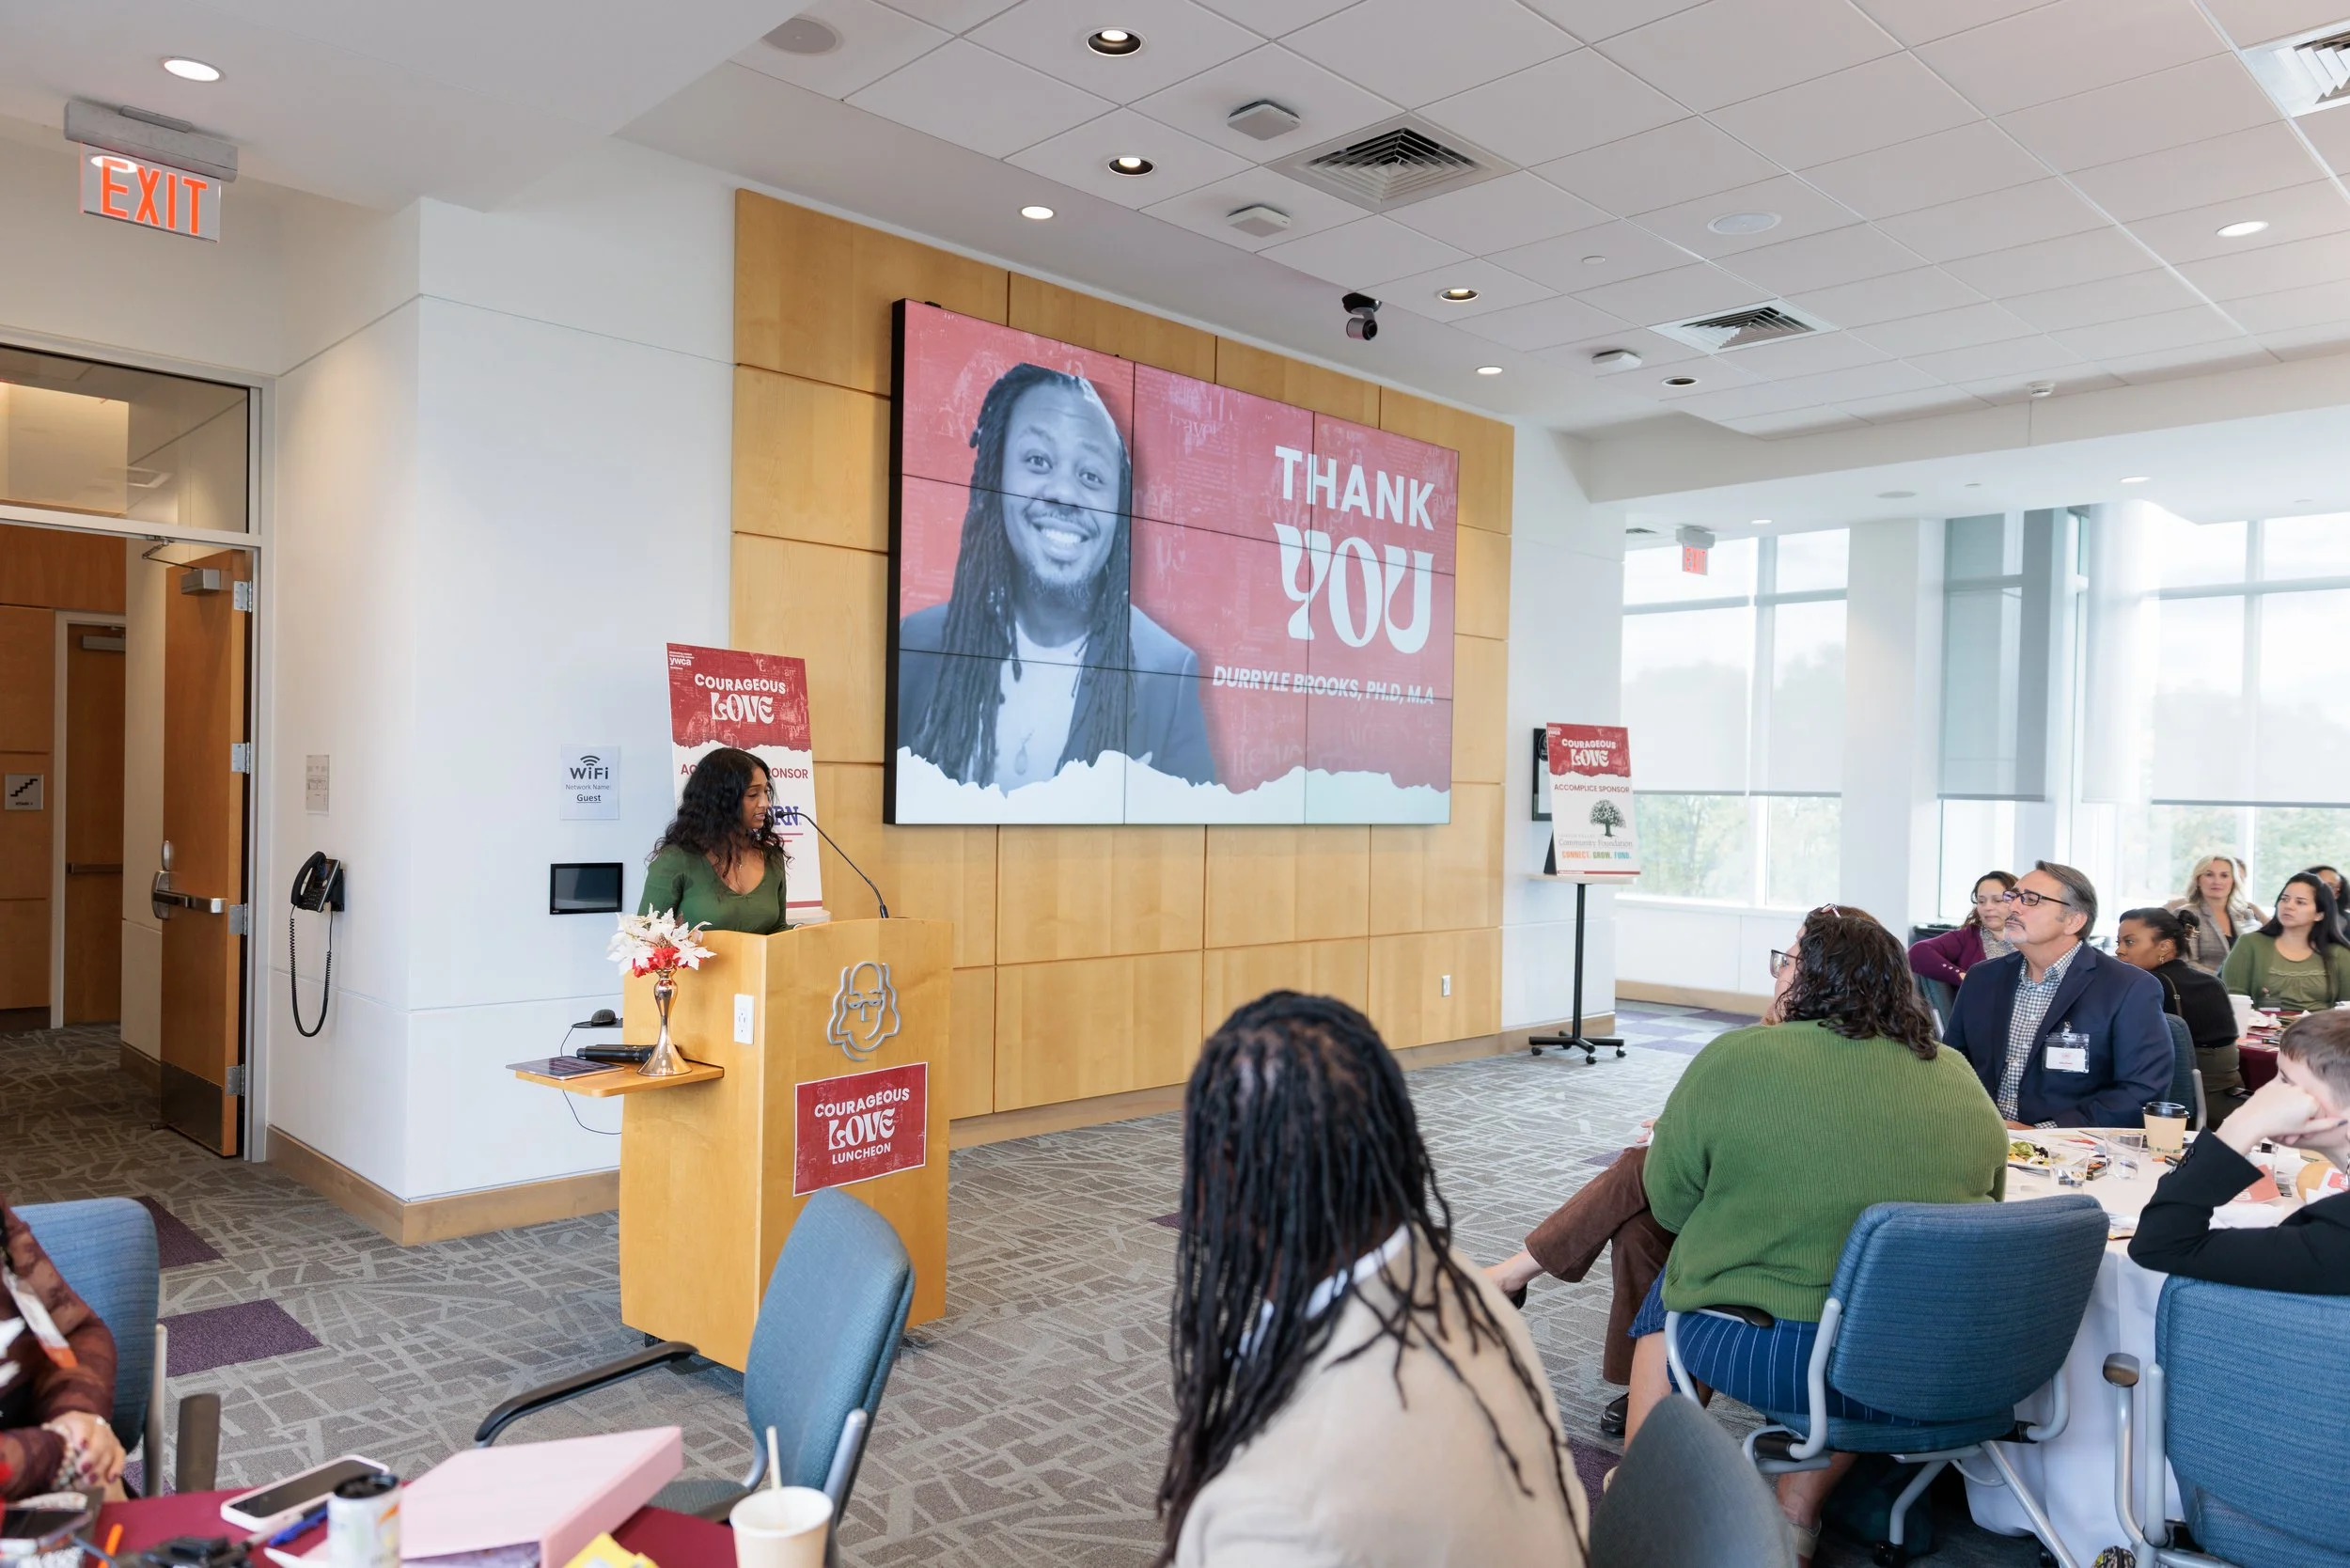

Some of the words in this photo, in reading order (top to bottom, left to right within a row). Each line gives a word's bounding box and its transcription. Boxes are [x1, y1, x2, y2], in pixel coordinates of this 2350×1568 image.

[101, 155, 208, 235] EXIT
[1275, 445, 1435, 531] THANK
[1685, 546, 1707, 573] EXIT
[1273, 522, 1434, 654] YOU
[669, 657, 692, 666] ywca
[694, 673, 787, 695] COURAGEOUS
[1213, 666, 1291, 692] DURRYLE
[1292, 673, 1363, 700] BROOKS,
[1366, 680, 1402, 705] PH.D,
[711, 692, 775, 724] LOVE
[1561, 739, 1617, 749] COURAGEOUS
[1570, 748, 1609, 767] LOVE
[570, 767, 609, 780] WiFi
[769, 767, 808, 779] ONSOR
[576, 793, 602, 802] Guest
[1554, 784, 1598, 792] ACCOMPLICE
[1559, 839, 1596, 848] Community
[1598, 839, 1633, 848] Foundation
[814, 1088, 910, 1118] COURAGEOUS
[828, 1107, 896, 1151] LOVE
[832, 1142, 891, 1165] LUNCHEON
